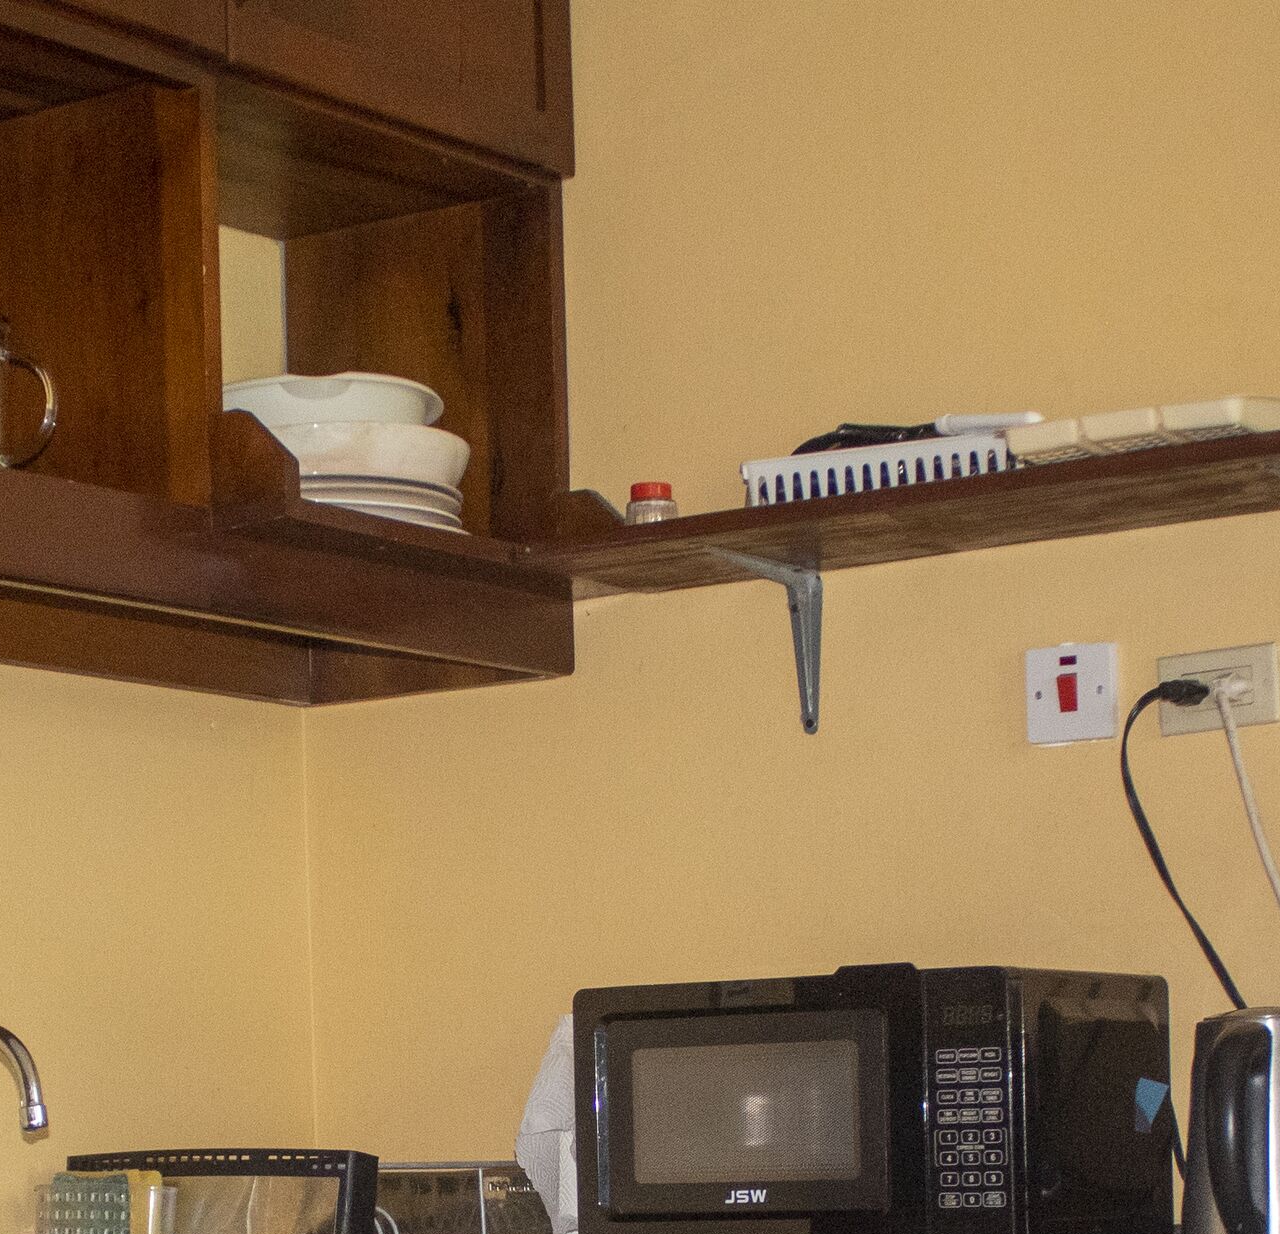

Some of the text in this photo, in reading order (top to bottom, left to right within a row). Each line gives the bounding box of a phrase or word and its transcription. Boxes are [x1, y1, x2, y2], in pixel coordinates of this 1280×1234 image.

[967, 1133, 973, 1141] 2
[989, 1132, 995, 1140] 3
[725, 1189, 767, 1204] JSW
